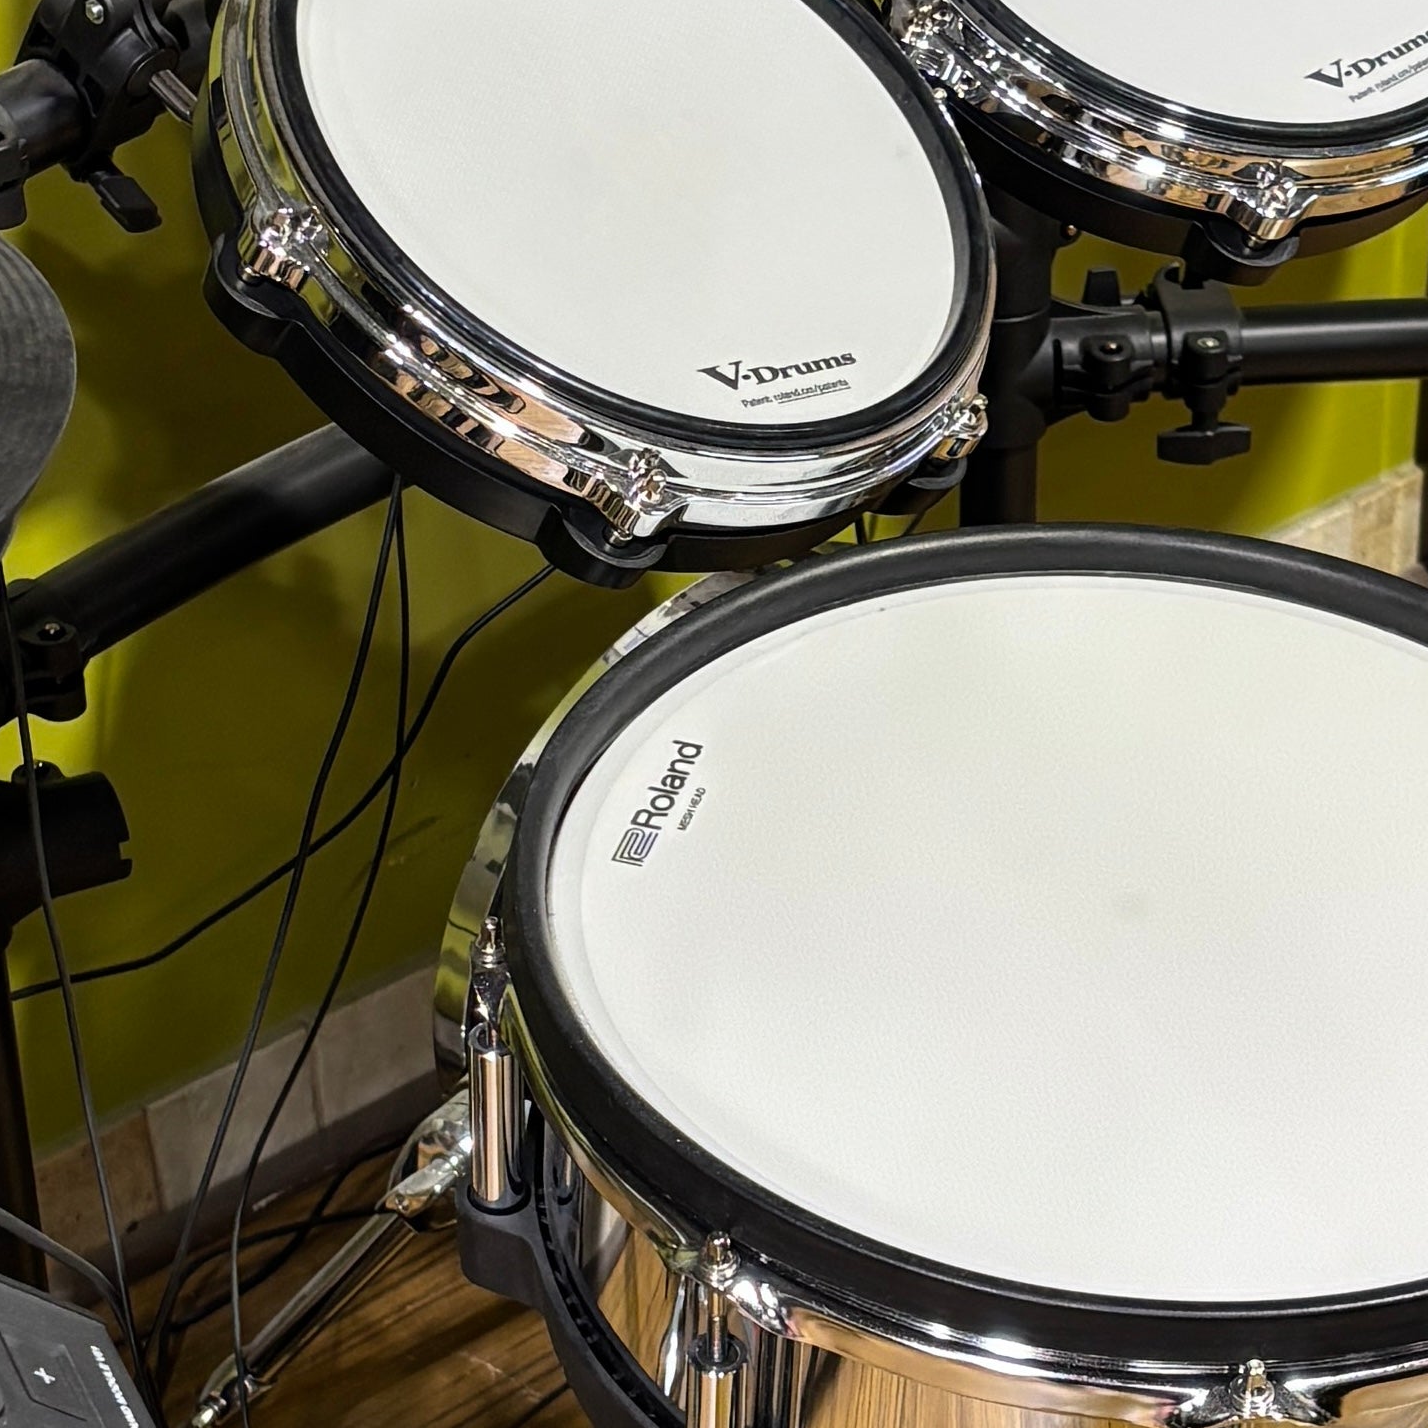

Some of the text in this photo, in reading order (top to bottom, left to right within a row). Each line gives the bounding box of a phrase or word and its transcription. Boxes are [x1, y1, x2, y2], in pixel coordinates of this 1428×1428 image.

[632, 739, 704, 830] Roland
[677, 786, 706, 831] MESH HEAD
